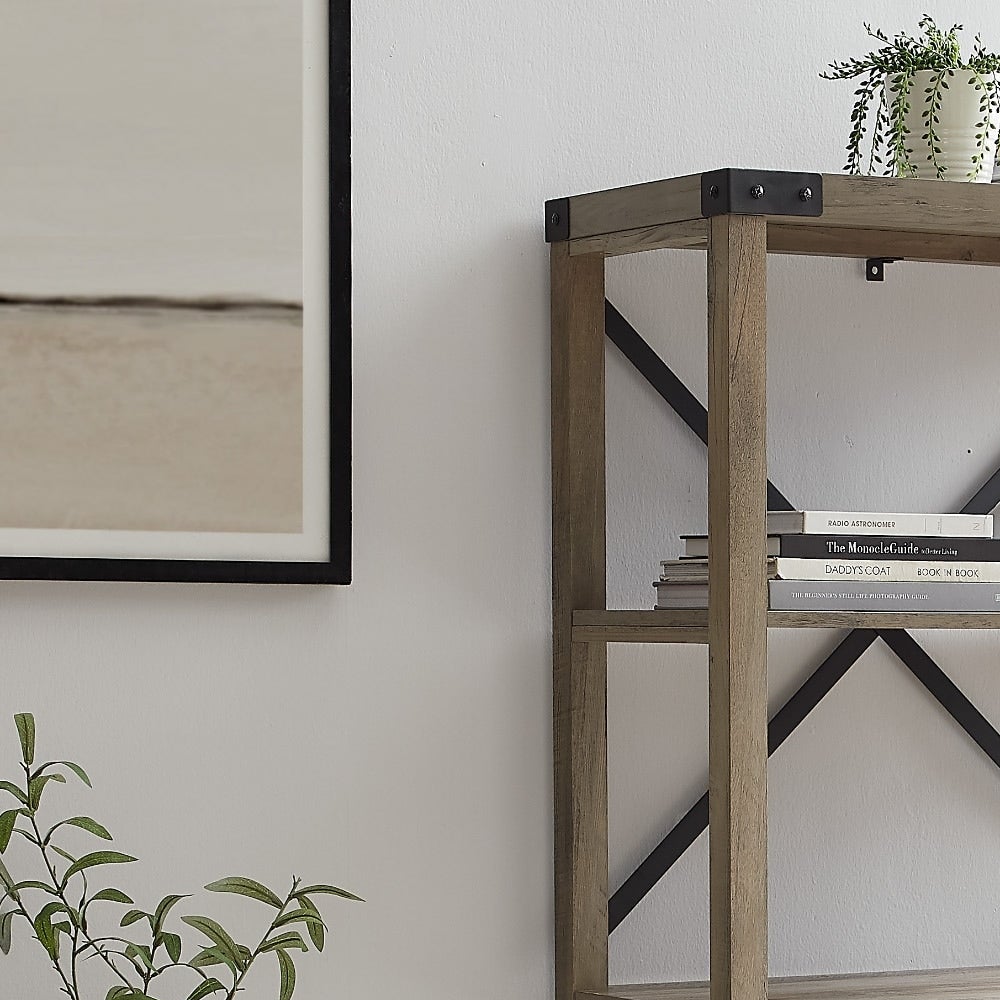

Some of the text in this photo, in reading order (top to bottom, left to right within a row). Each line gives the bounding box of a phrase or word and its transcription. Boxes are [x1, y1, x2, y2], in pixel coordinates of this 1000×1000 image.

[827, 520, 896, 528] RADIO ASTRONOMER
[826, 541, 846, 554] The
[825, 564, 979, 578] DADDY'S COAT BOOK IN BOOK
